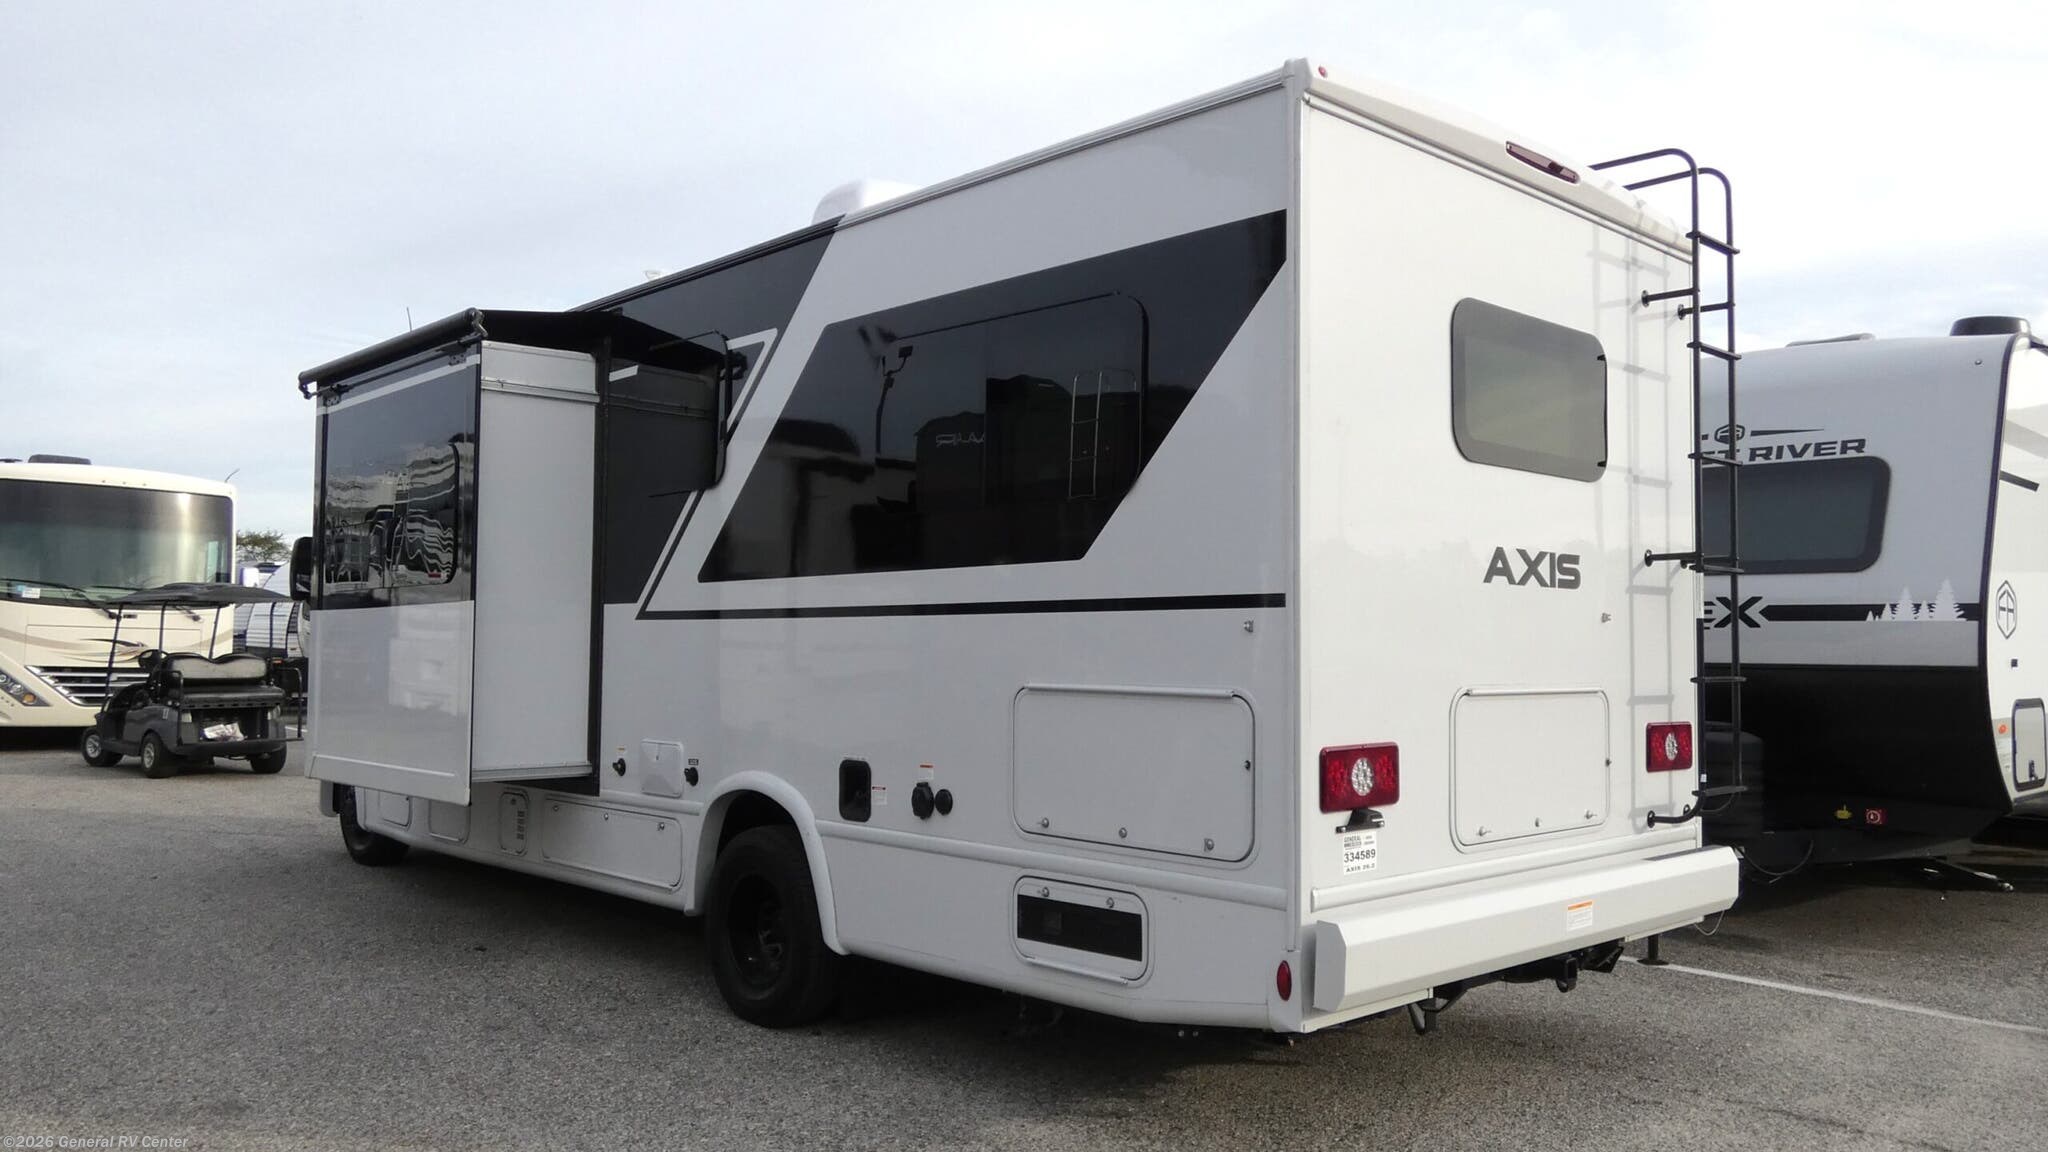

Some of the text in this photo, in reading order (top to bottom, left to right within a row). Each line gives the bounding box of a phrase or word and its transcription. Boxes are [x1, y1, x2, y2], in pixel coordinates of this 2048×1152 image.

[1748, 438, 1867, 462] RIVER
[1483, 546, 1581, 590] AXIS
[1344, 848, 1376, 862] 334589
